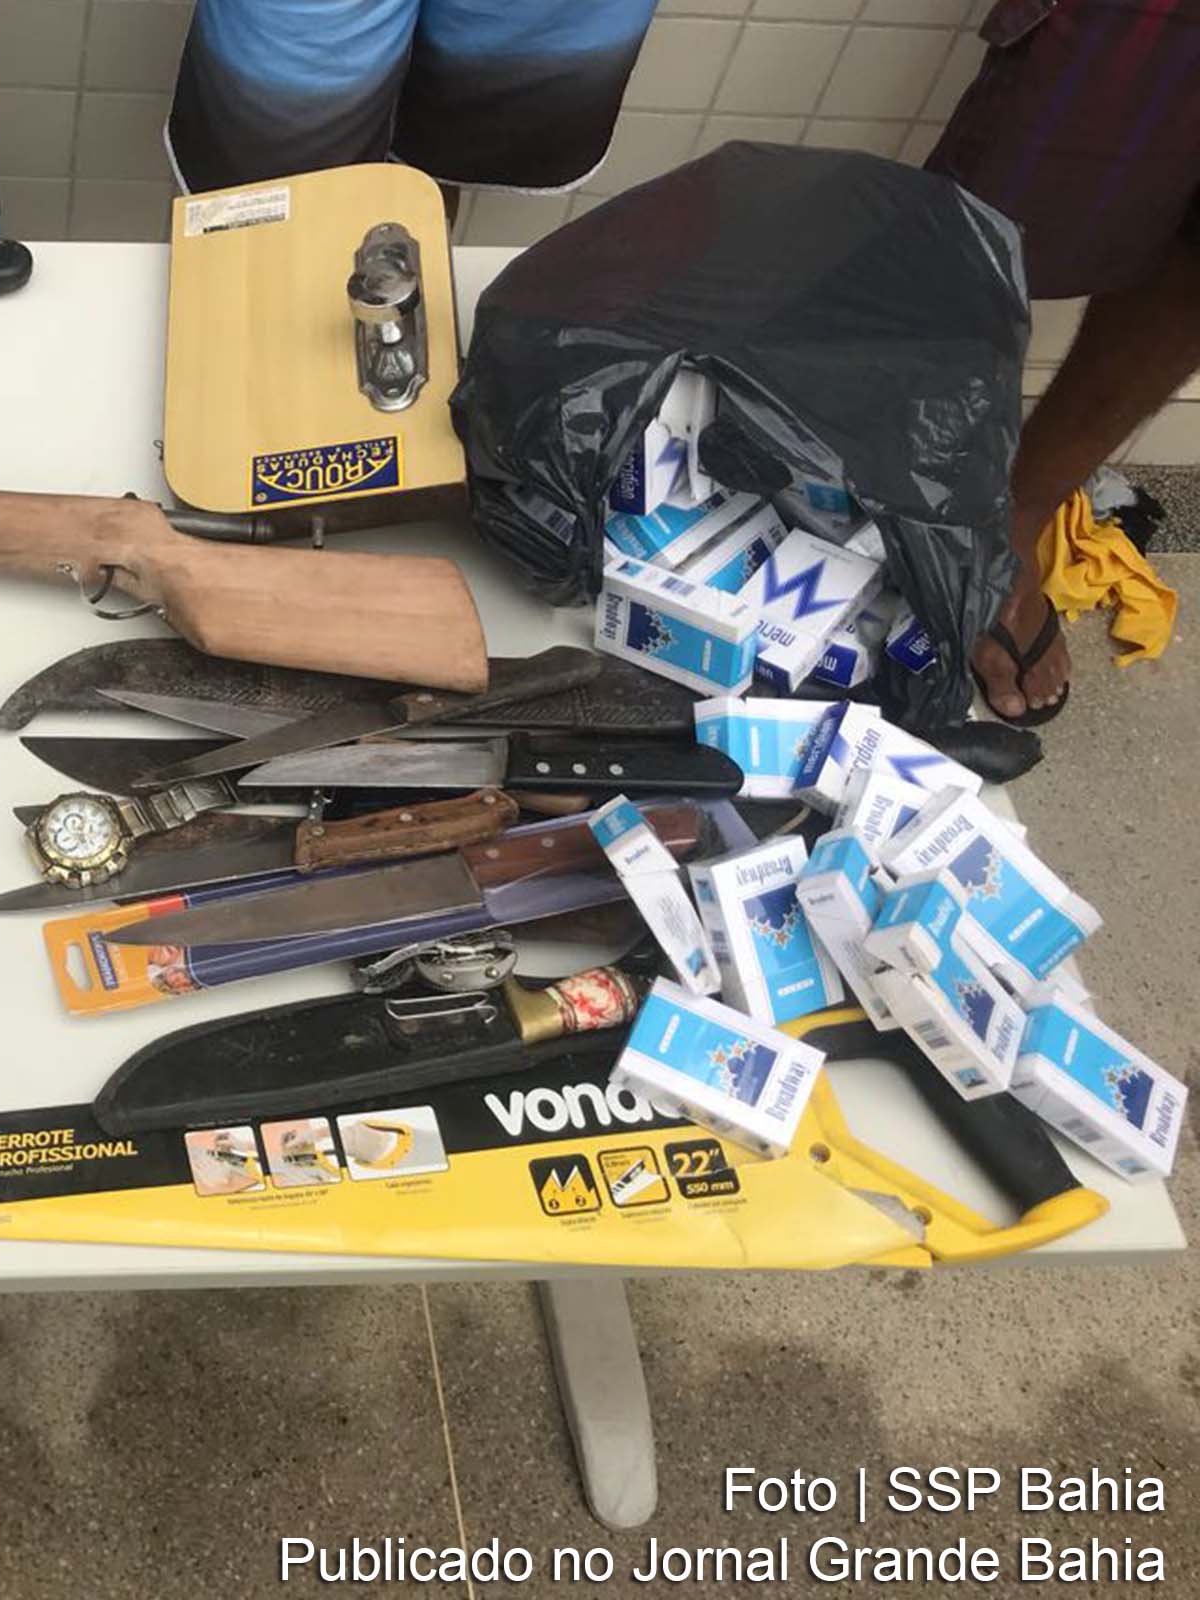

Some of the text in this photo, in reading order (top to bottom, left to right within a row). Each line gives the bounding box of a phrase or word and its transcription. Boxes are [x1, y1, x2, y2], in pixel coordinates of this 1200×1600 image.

[256, 446, 394, 473] FECHADURAS
[257, 454, 393, 490] AROUCA
[764, 1061, 811, 1122] Broadway
[686, 1179, 735, 1194] 550 mm
